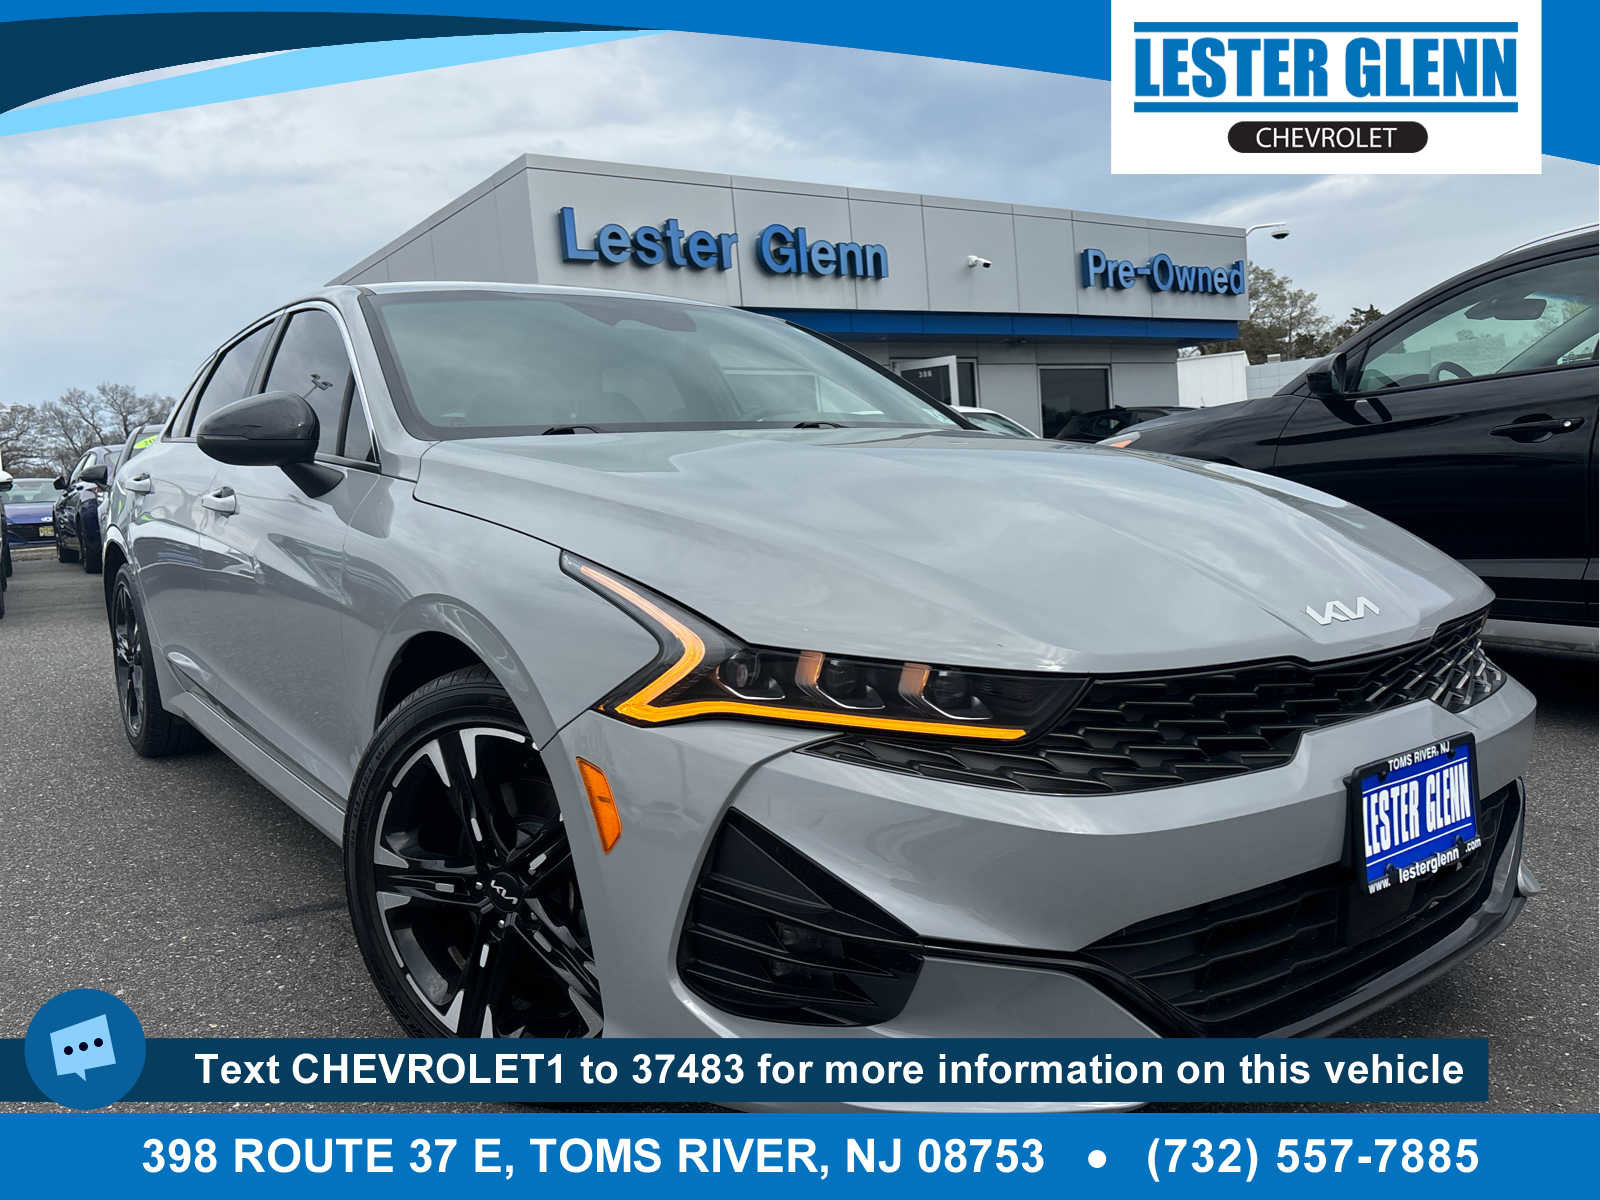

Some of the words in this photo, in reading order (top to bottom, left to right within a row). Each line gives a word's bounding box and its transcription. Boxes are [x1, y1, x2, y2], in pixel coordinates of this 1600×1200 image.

[557, 206, 738, 272] Lester
[756, 223, 889, 279] Glenn
[1080, 248, 1246, 296] Pre-Owned
[1388, 753, 1413, 772] TOMS
[1440, 741, 1450, 756] NJ
[1362, 780, 1420, 858] LESTER
[1425, 761, 1471, 833] GLENN
[1399, 847, 1460, 884] lesterglenn
